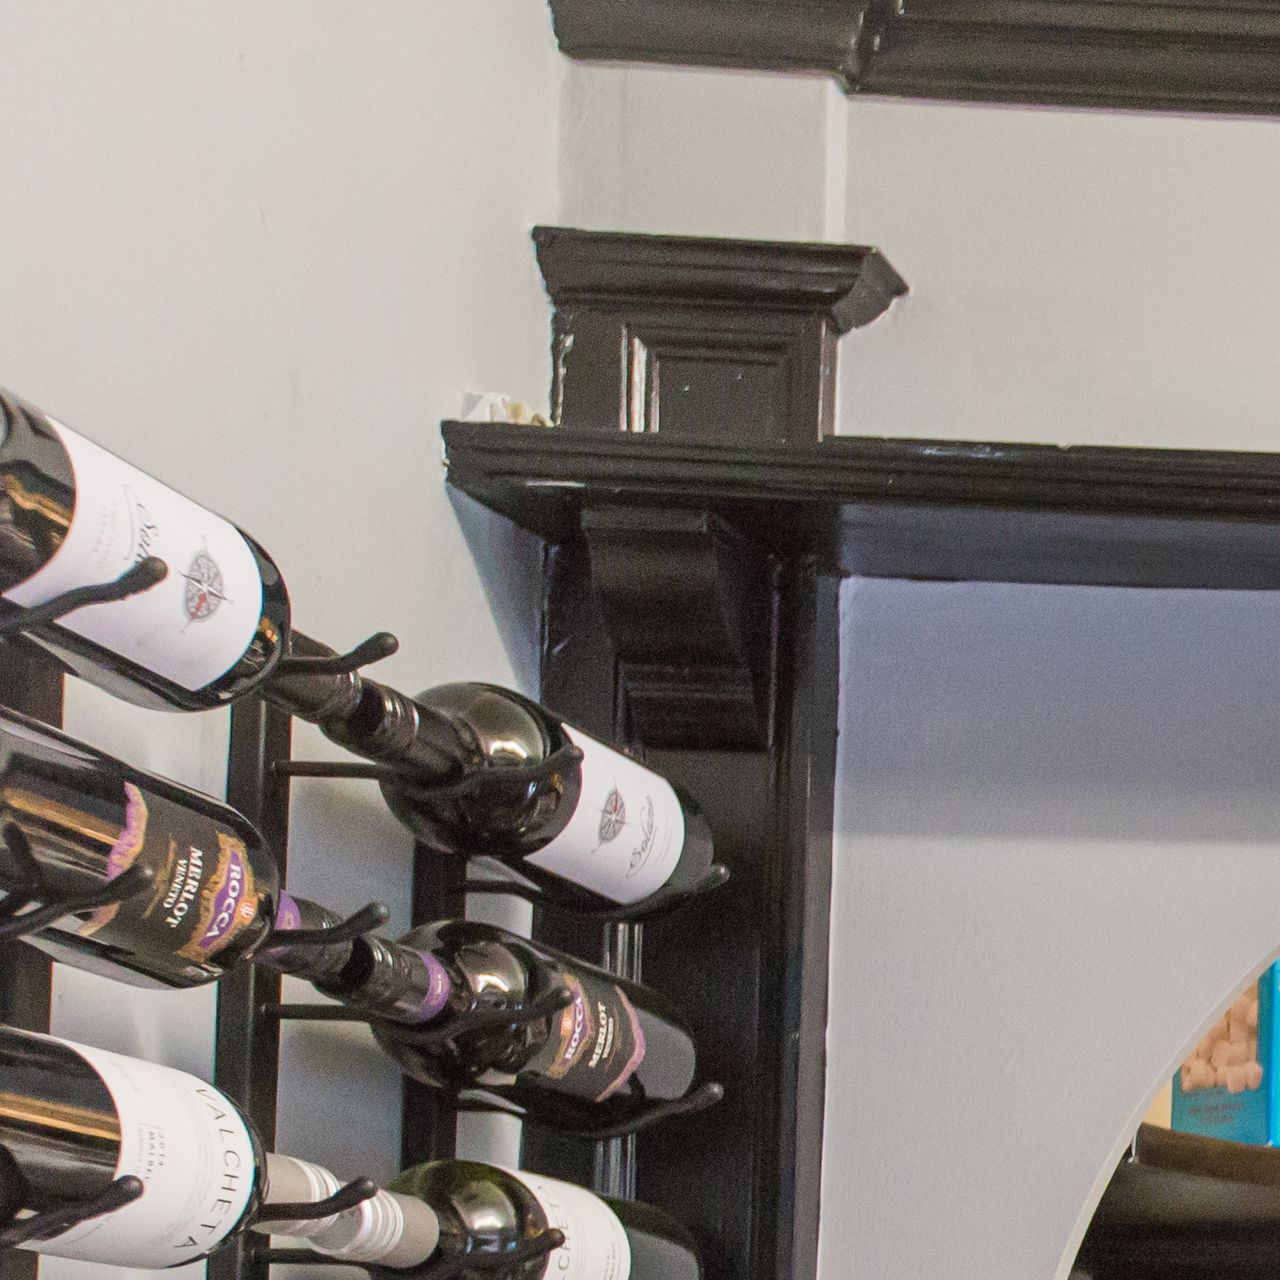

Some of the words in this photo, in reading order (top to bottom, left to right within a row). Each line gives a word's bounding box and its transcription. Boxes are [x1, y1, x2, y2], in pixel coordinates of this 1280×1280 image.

[162, 859, 188, 908] VENETO
[165, 846, 202, 928] MERLOT
[205, 863, 242, 937] ROCCA
[588, 1001, 608, 1068] MERLOT
[174, 1088, 241, 1249] VALCHETA
